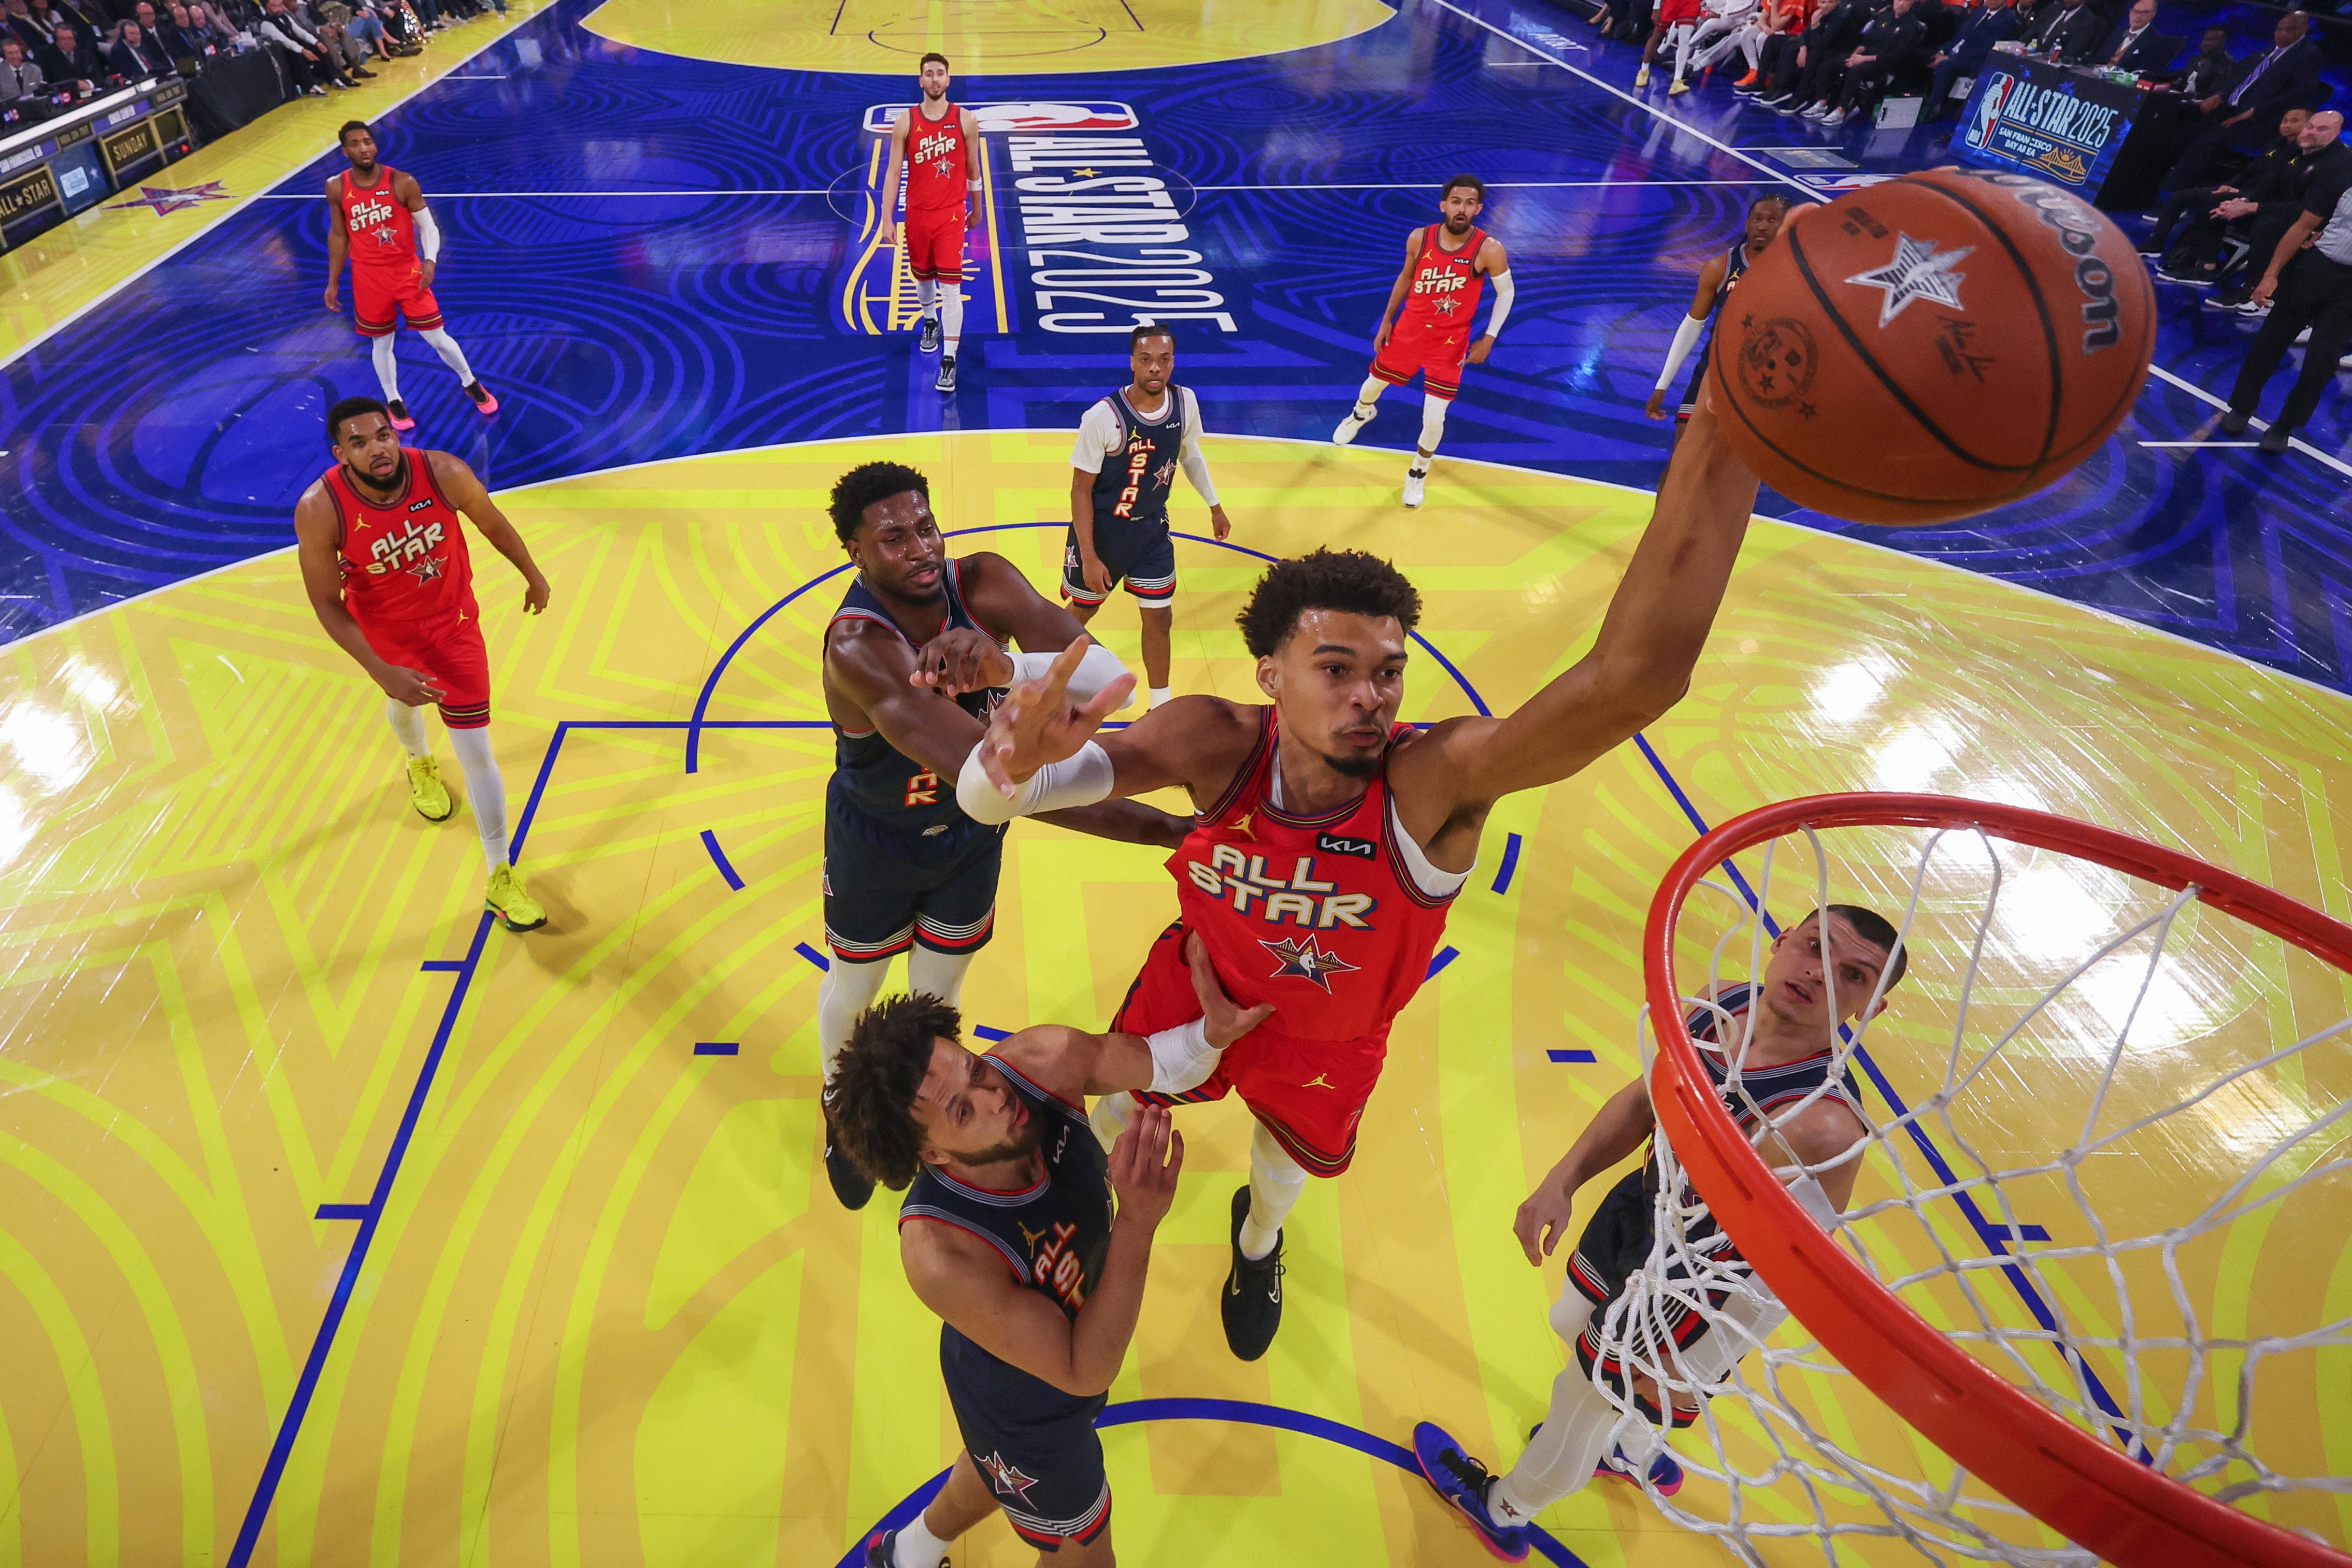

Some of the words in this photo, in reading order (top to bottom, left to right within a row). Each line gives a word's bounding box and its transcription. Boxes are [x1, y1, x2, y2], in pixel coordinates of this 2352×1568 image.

[1999, 127, 2013, 138] SAN
[2068, 101, 2118, 148] 2025
[112, 132, 148, 161] SUNDAY
[914, 137, 956, 164] STAR
[920, 131, 948, 150] ALL
[350, 205, 393, 232] STAR
[351, 198, 382, 218] ALL
[1414, 276, 1467, 294] STAR
[1421, 265, 1457, 280] ALL
[1028, 249, 1238, 333] 2025
[1128, 438, 1156, 454] ALL
[1113, 452, 1149, 519] STAR
[365, 522, 447, 574] STAR
[370, 519, 424, 561] ALL
[1211, 843, 1337, 894] ALL
[1188, 860, 1376, 930] STAR
[1034, 1220, 1078, 1285] ALL
